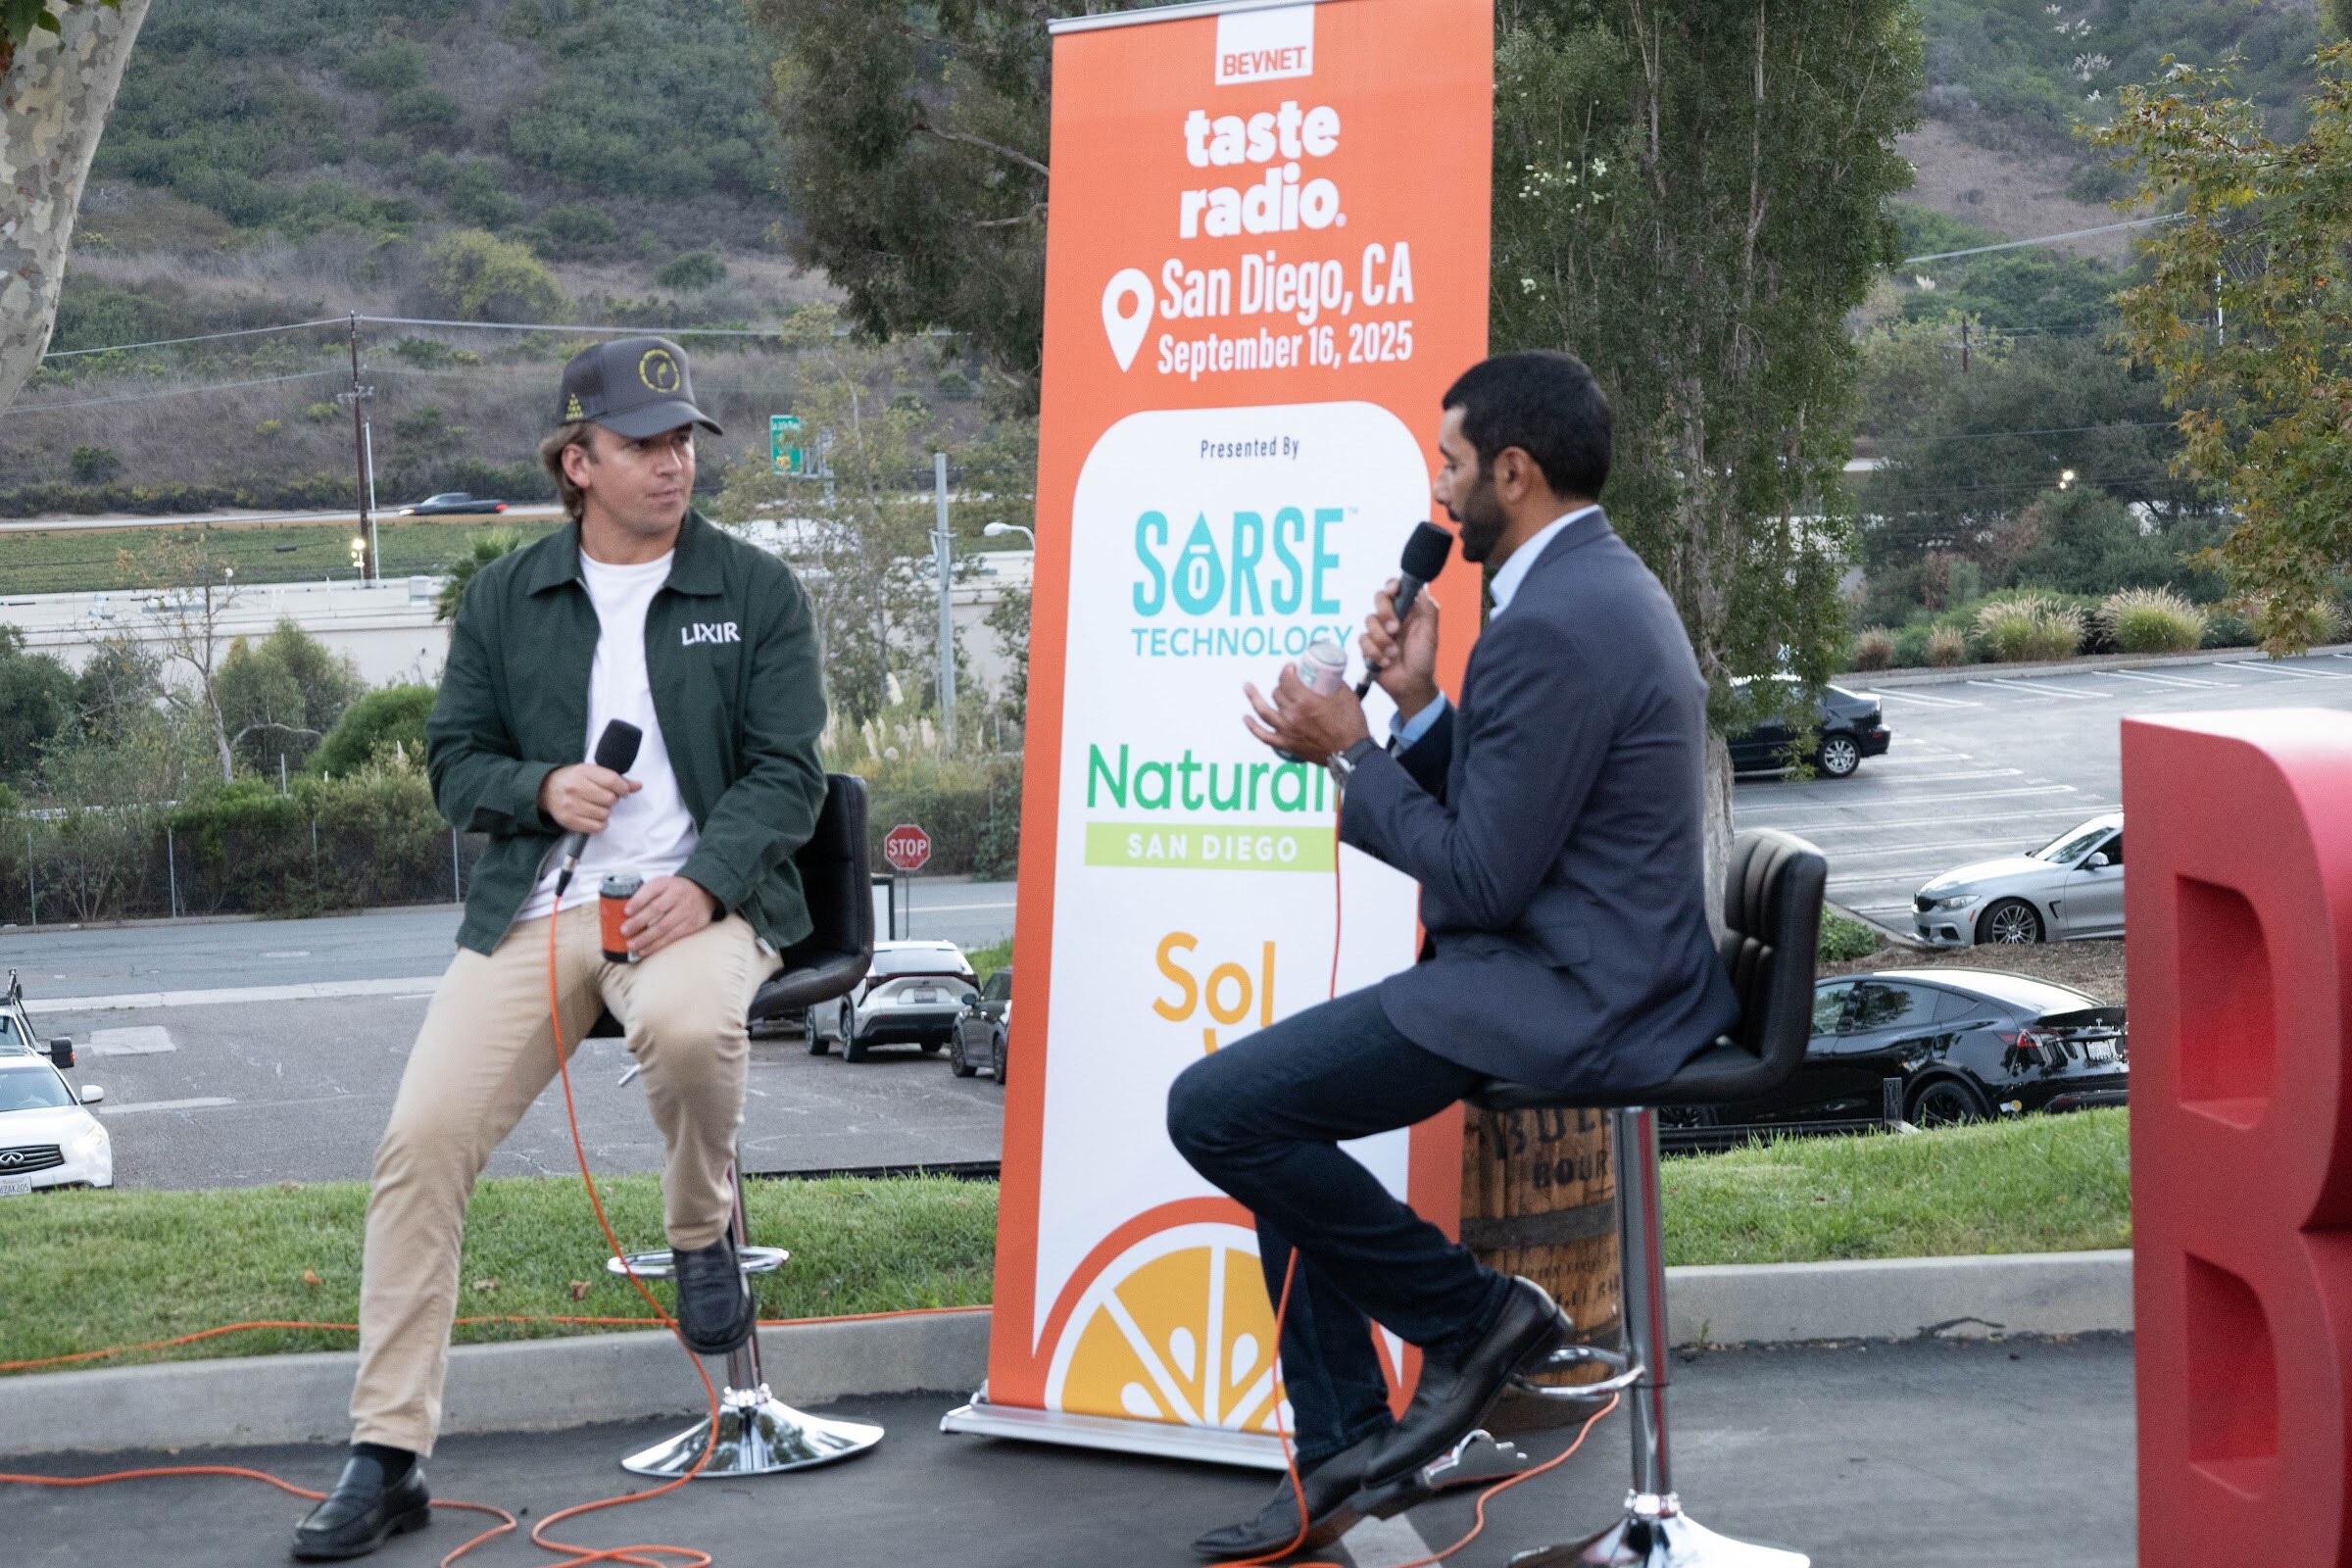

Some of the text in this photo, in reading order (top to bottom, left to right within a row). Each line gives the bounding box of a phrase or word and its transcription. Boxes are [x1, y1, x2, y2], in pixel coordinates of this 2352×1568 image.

[1223, 46, 1305, 76] BEVNET
[1184, 101, 1341, 168] taste
[1160, 241, 1414, 325] San Diego, CA
[1157, 320, 1413, 382] September 16, 2025
[1200, 436, 1299, 461] Presented By
[681, 621, 741, 646] LIXIR
[1131, 625, 1352, 657] TECHNOLOGY
[1088, 743, 1337, 811] Natural
[888, 838, 927, 858] STOP
[1127, 833, 1298, 862] SAN DIEGO
[1152, 931, 1276, 1027] Sol
